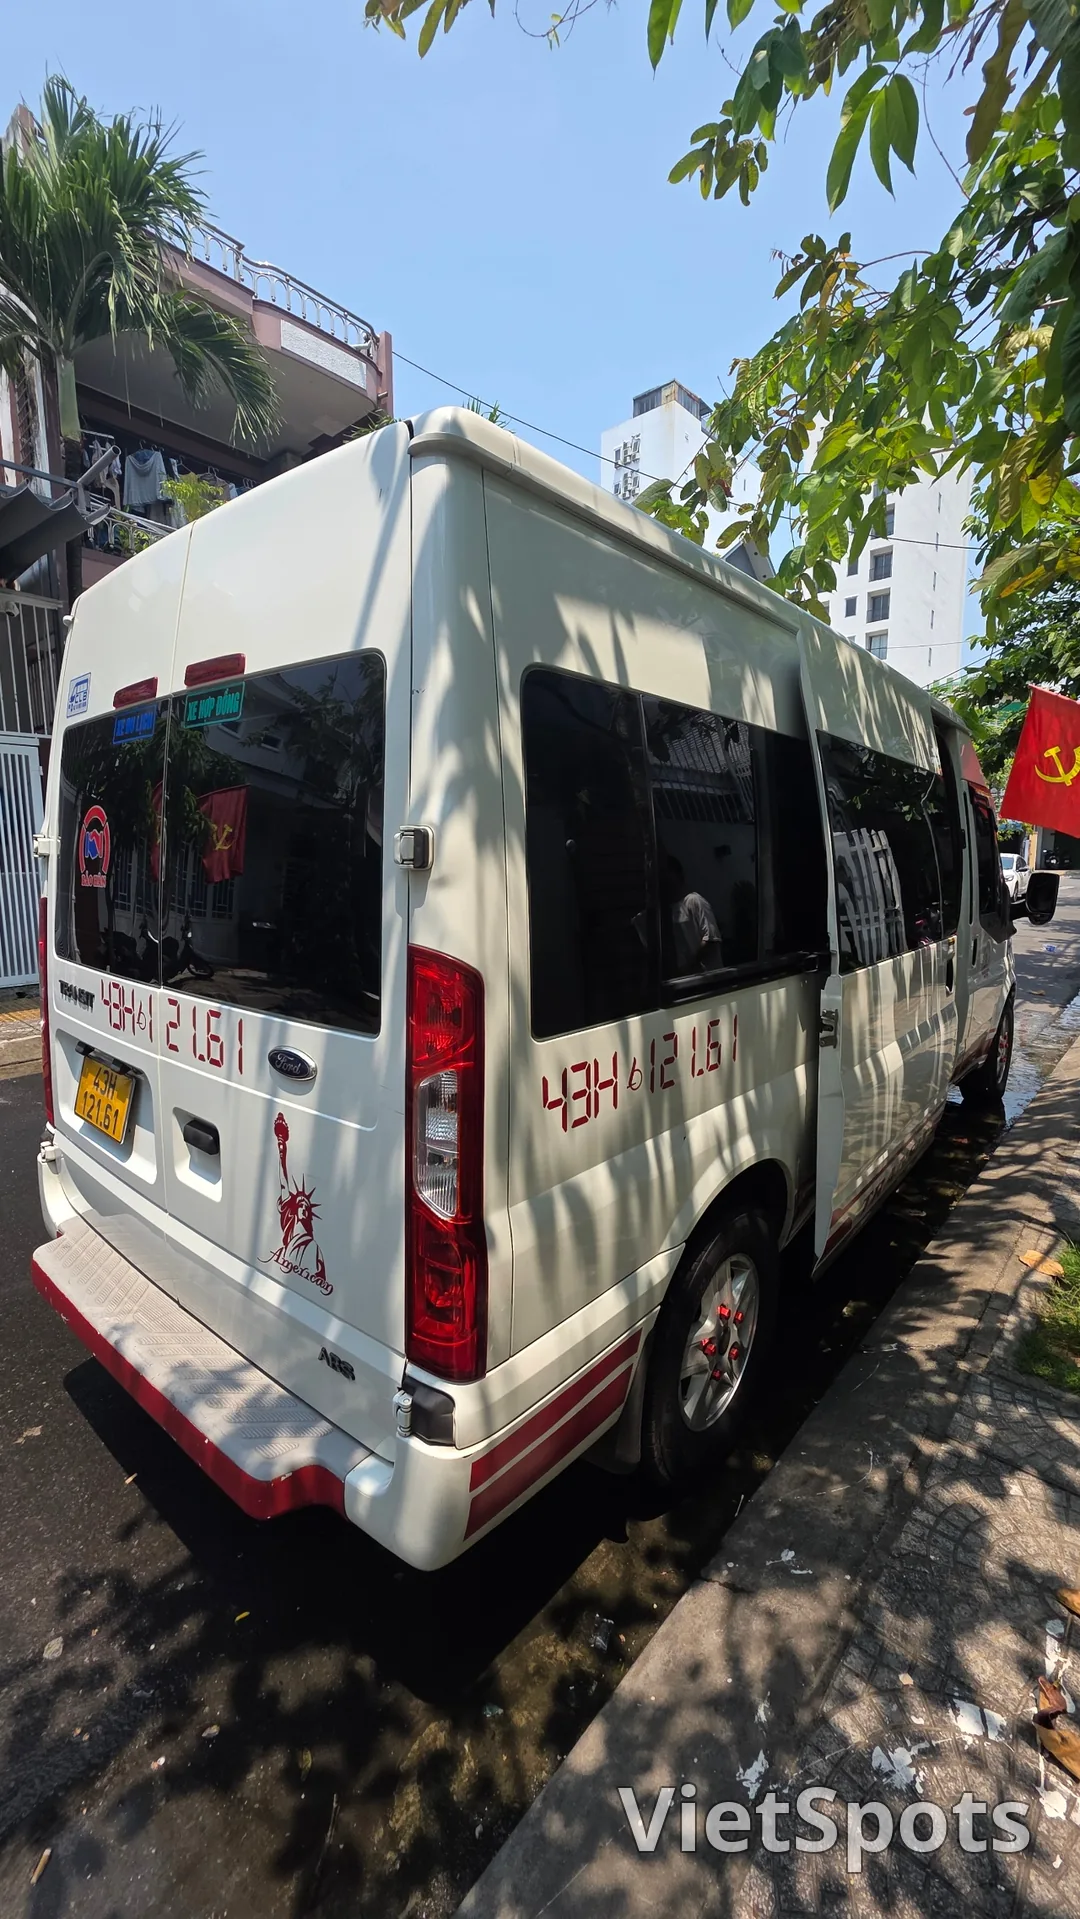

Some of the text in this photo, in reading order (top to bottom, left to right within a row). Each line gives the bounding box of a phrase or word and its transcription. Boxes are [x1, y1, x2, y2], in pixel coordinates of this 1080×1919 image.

[187, 688, 240, 723] XE HỢP ĐỒNG
[58, 979, 95, 1010] TRANSIT
[275, 1053, 302, 1075] Ford
[93, 1067, 118, 1101] 43H
[82, 1091, 119, 1135] 121.61
[257, 1247, 334, 1296] American
[318, 1347, 356, 1381] ABS
